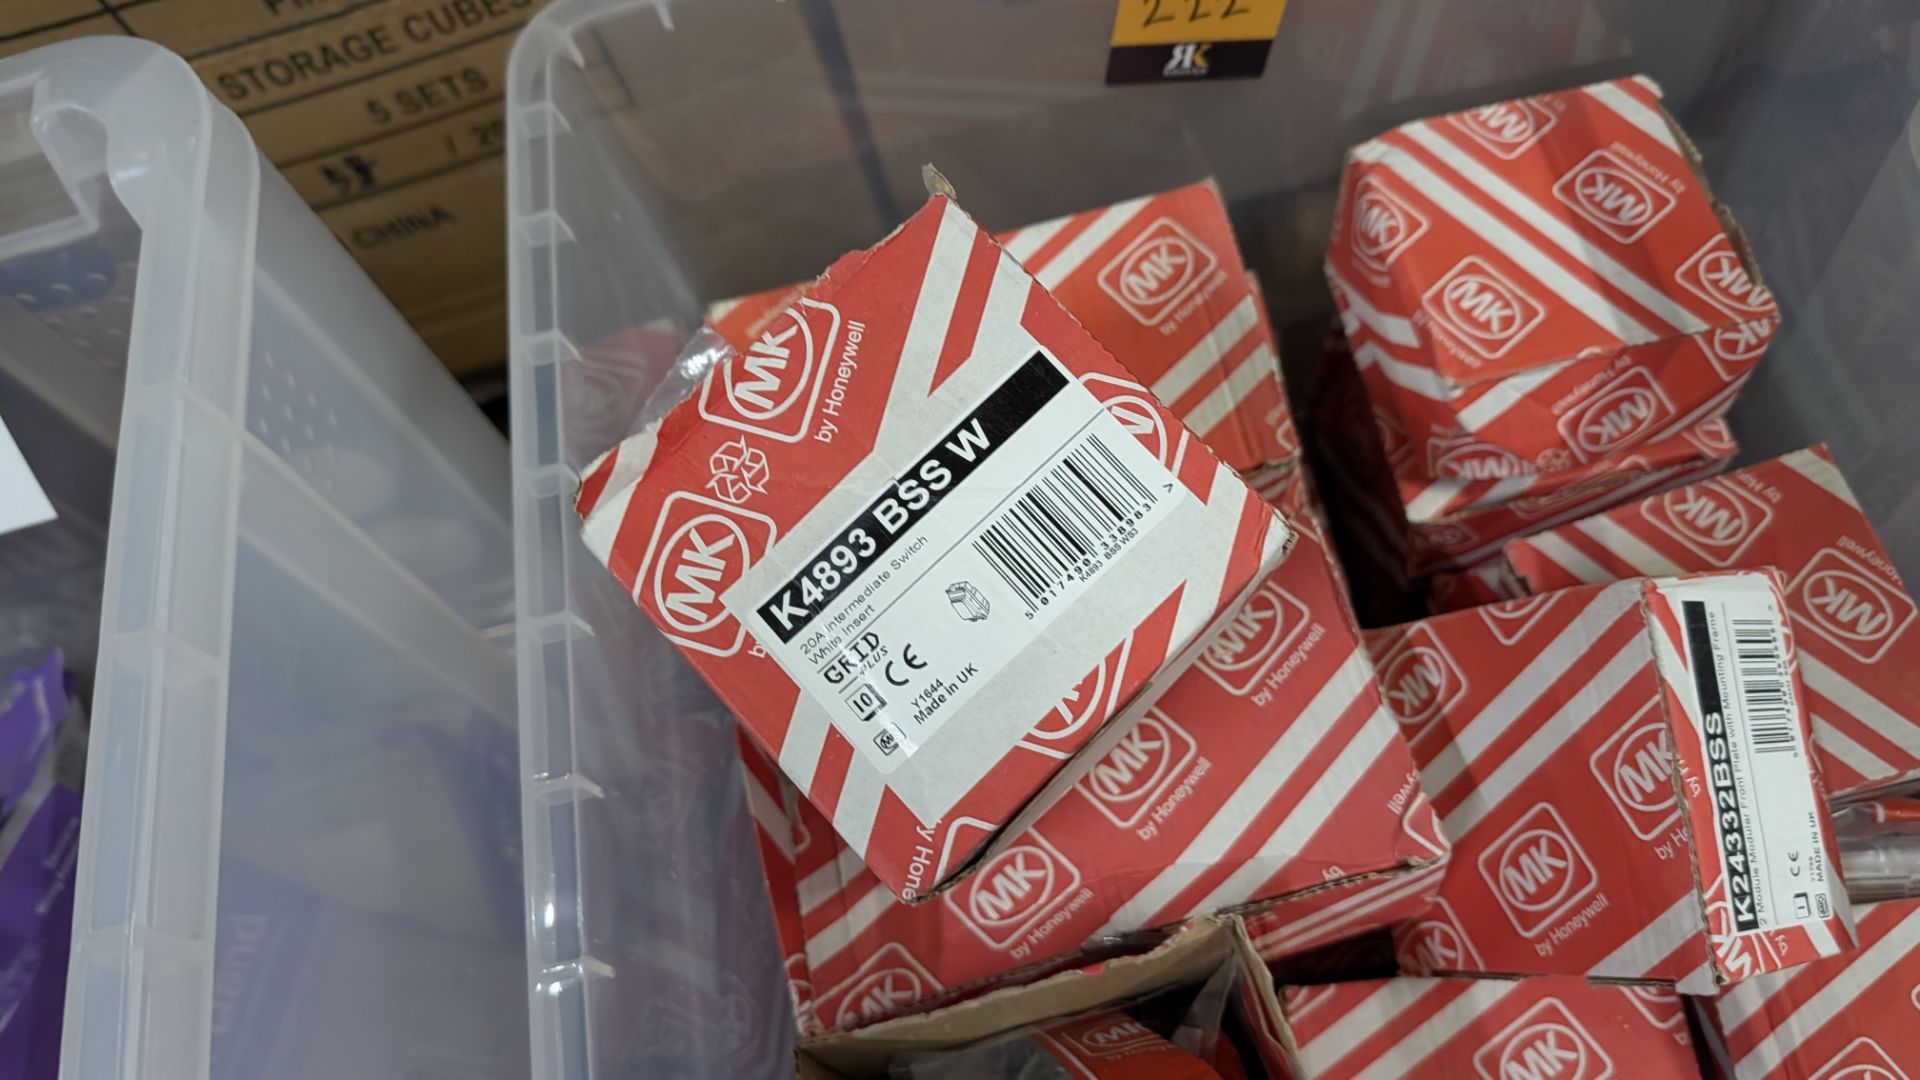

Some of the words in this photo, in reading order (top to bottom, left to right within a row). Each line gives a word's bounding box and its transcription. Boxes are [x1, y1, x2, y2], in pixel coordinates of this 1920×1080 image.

[217, 23, 397, 100] STORAGE
[366, 99, 391, 124] 5
[395, 67, 488, 114] SETS
[1583, 173, 1647, 222] MK
[353, 205, 453, 249] CHINA
[1128, 240, 1189, 301] MK
[1175, 269, 1230, 325] Honeywell
[1453, 281, 1514, 333] MK
[733, 323, 799, 410] MK
[822, 320, 866, 416] Honeywell
[815, 419, 838, 443] by
[1583, 395, 1648, 444] MK
[769, 528, 877, 631] K4893
[872, 459, 952, 535] BSS
[945, 418, 991, 462] W
[1673, 486, 1741, 541] MK
[665, 527, 736, 623] MK
[800, 630, 826, 655] 20A
[825, 570, 891, 633] Intermediate
[892, 534, 928, 571] Switch
[1079, 560, 1104, 583] K4893
[1708, 611, 1722, 650] Frame
[1812, 577, 1887, 635] MK
[808, 635, 842, 665] White
[842, 604, 876, 639] Insert
[823, 632, 880, 684] GRID
[1251, 687, 1273, 708] by
[1266, 622, 1326, 690] Honeywell
[1386, 654, 1441, 716] MK
[1716, 653, 1731, 709] Mounting
[910, 678, 944, 709] Y1644
[913, 692, 947, 725] Made
[946, 681, 960, 697] in
[957, 662, 979, 685] UK
[1725, 713, 1736, 741] with
[1097, 724, 1162, 795] MK
[1619, 730, 1675, 802] MK
[1732, 744, 1744, 774] Plate
[1136, 821, 1159, 841] by
[1151, 756, 1213, 824] Honeywell
[1387, 769, 1420, 815] ywell
[1705, 711, 1754, 922] K24332BSS
[1737, 778, 1749, 811] Front
[1808, 812, 1816, 826] UK
[916, 822, 938, 842] y
[1654, 841, 1674, 860] by
[1744, 813, 1758, 863] Modular
[1812, 832, 1819, 845] IN
[977, 851, 1047, 920] MK
[1503, 836, 1567, 901] MK
[1751, 866, 1765, 914] Module
[1814, 846, 1825, 882] MADE
[1009, 941, 1031, 959] by
[1027, 887, 1094, 944] Honeywell
[1534, 935, 1553, 957] by
[1549, 892, 1609, 944] Honeywell
[1760, 918, 1768, 926] 2
[1505, 1030, 1579, 1080] MK
